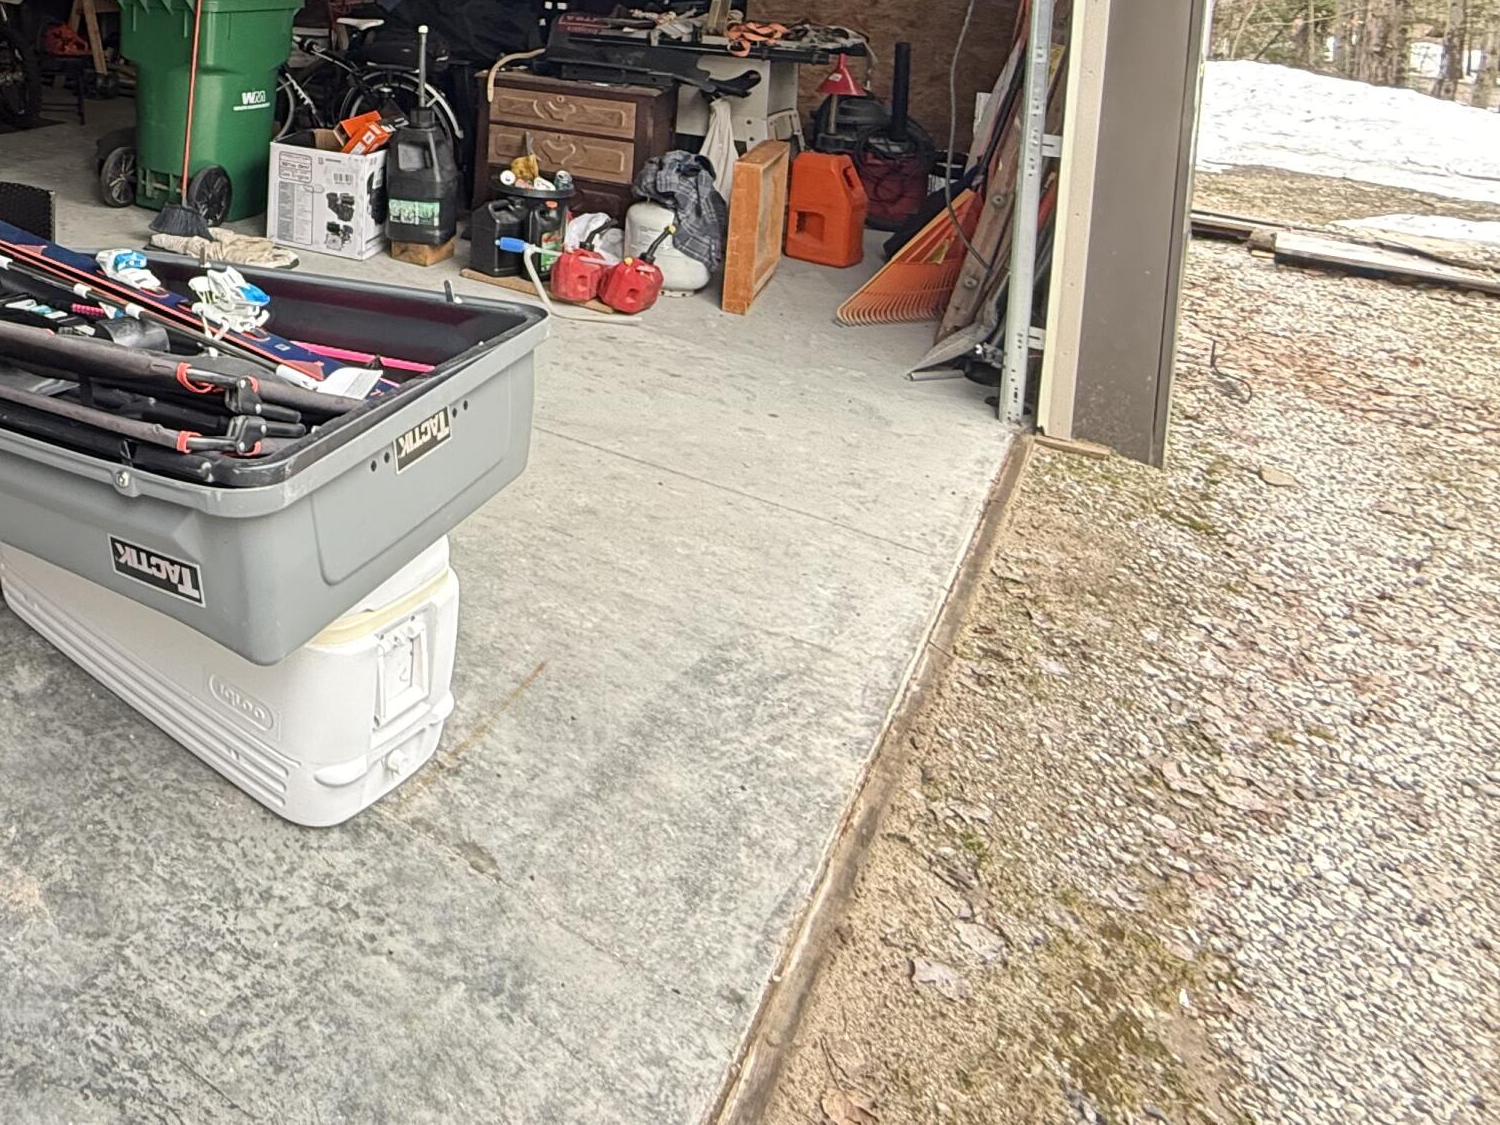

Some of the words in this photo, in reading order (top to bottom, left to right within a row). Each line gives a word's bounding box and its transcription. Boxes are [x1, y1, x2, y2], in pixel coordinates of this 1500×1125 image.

[241, 90, 266, 105] WM
[397, 411, 450, 459] TACTIK
[114, 542, 201, 599] TACTIK
[218, 683, 266, 720] igloo
